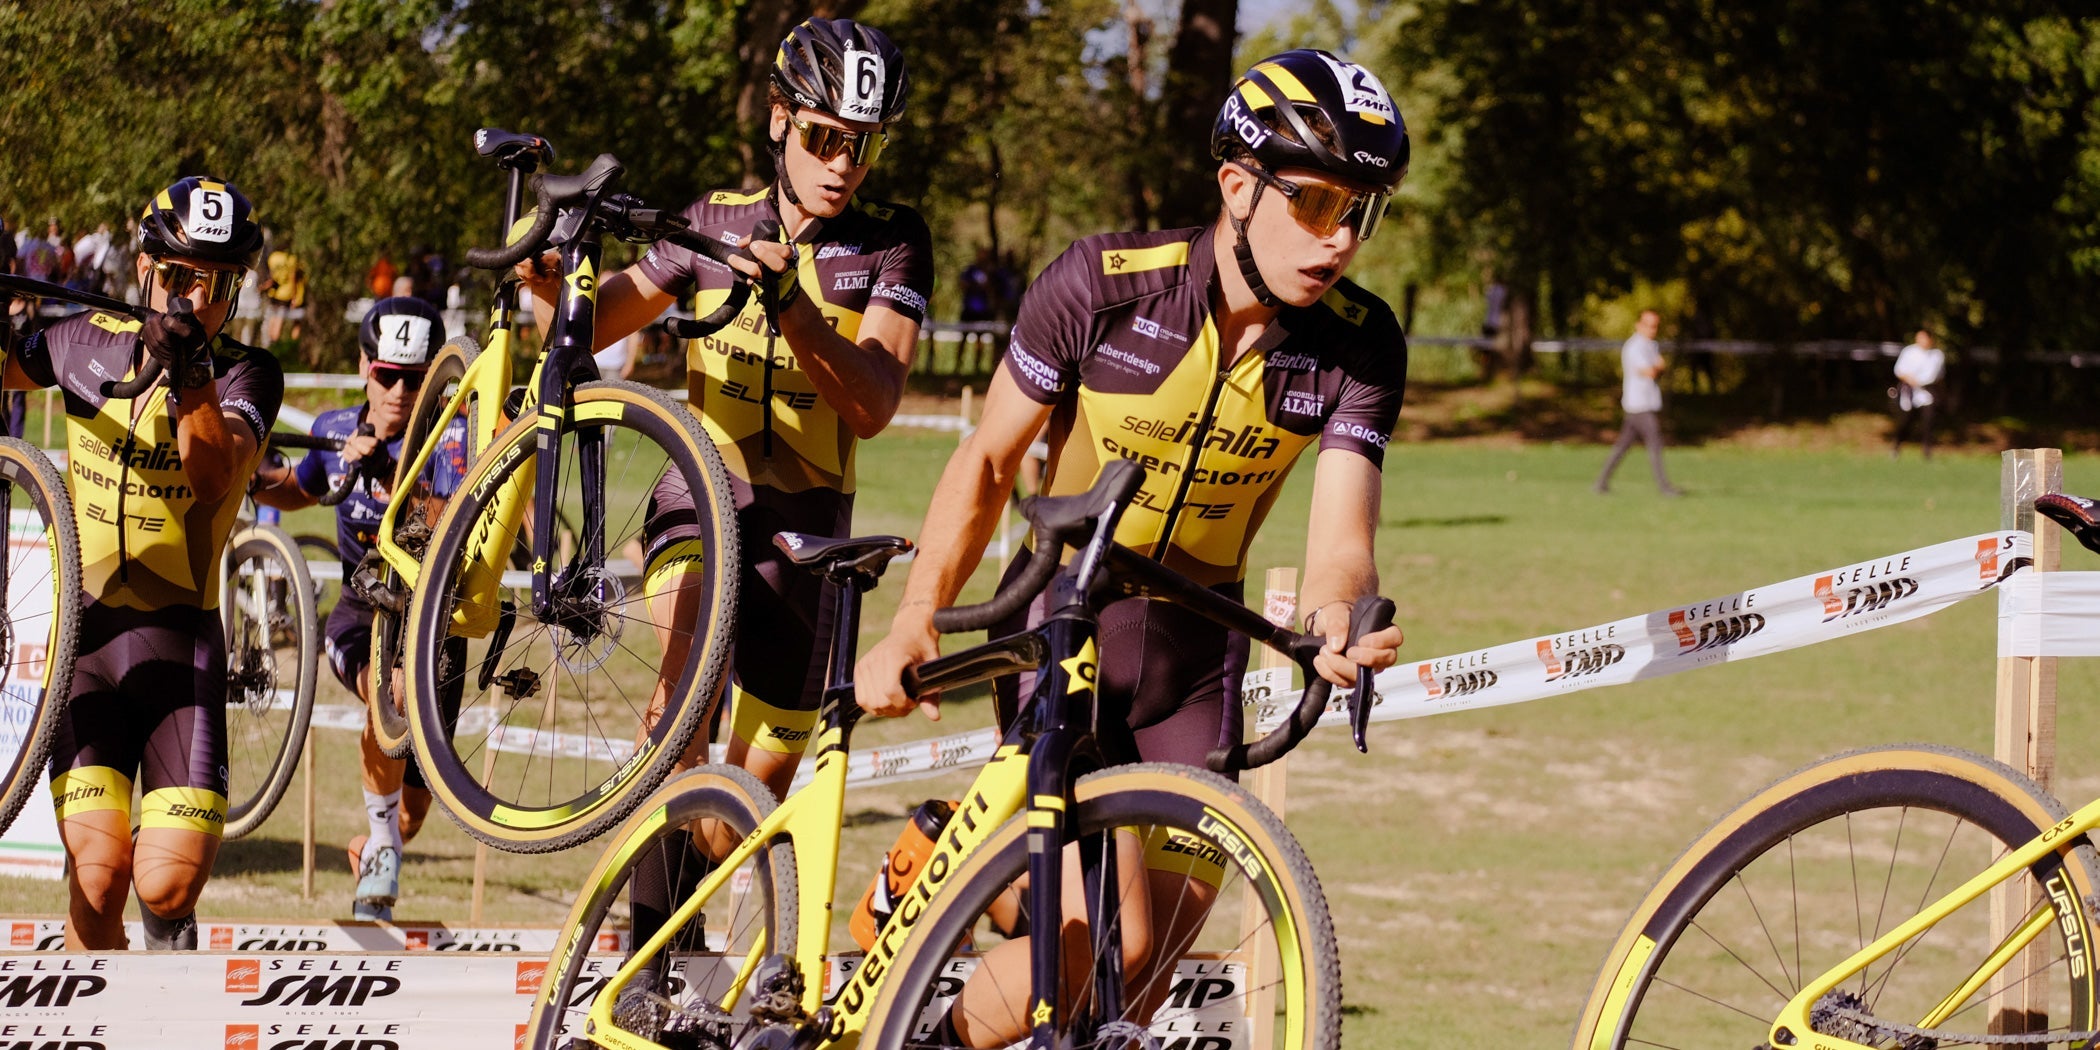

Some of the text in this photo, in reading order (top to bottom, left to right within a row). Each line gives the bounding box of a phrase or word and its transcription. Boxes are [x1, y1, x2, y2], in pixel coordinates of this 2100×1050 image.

[857, 56, 877, 100] 6
[1346, 97, 1390, 112] SMP
[202, 191, 223, 221] 5
[575, 275, 593, 291] G
[833, 277, 869, 291] ALMI
[395, 320, 411, 347] 4
[1138, 320, 1157, 336] UCI
[1097, 343, 1160, 375] albertdesign
[1280, 397, 1324, 417] ALMI
[473, 444, 521, 502] URSUS
[1835, 556, 1912, 586] SELLE
[1688, 594, 1757, 621] SELLE
[1555, 627, 1616, 650] SELLE
[1434, 652, 1488, 673] SELLE
[600, 736, 652, 796] URSUS
[2041, 815, 2075, 843] CXS
[1197, 815, 1262, 880] URSUS
[239, 927, 328, 936] SELLE
[2045, 876, 2086, 980] URSUS
[1, 959, 108, 971] ELLE
[269, 959, 402, 971] SELLE
[548, 923, 585, 1006] URSUS
[241, 975, 401, 1007] SMP
[2, 1025, 108, 1037] ELLE
[268, 1024, 400, 1035] SELLE
